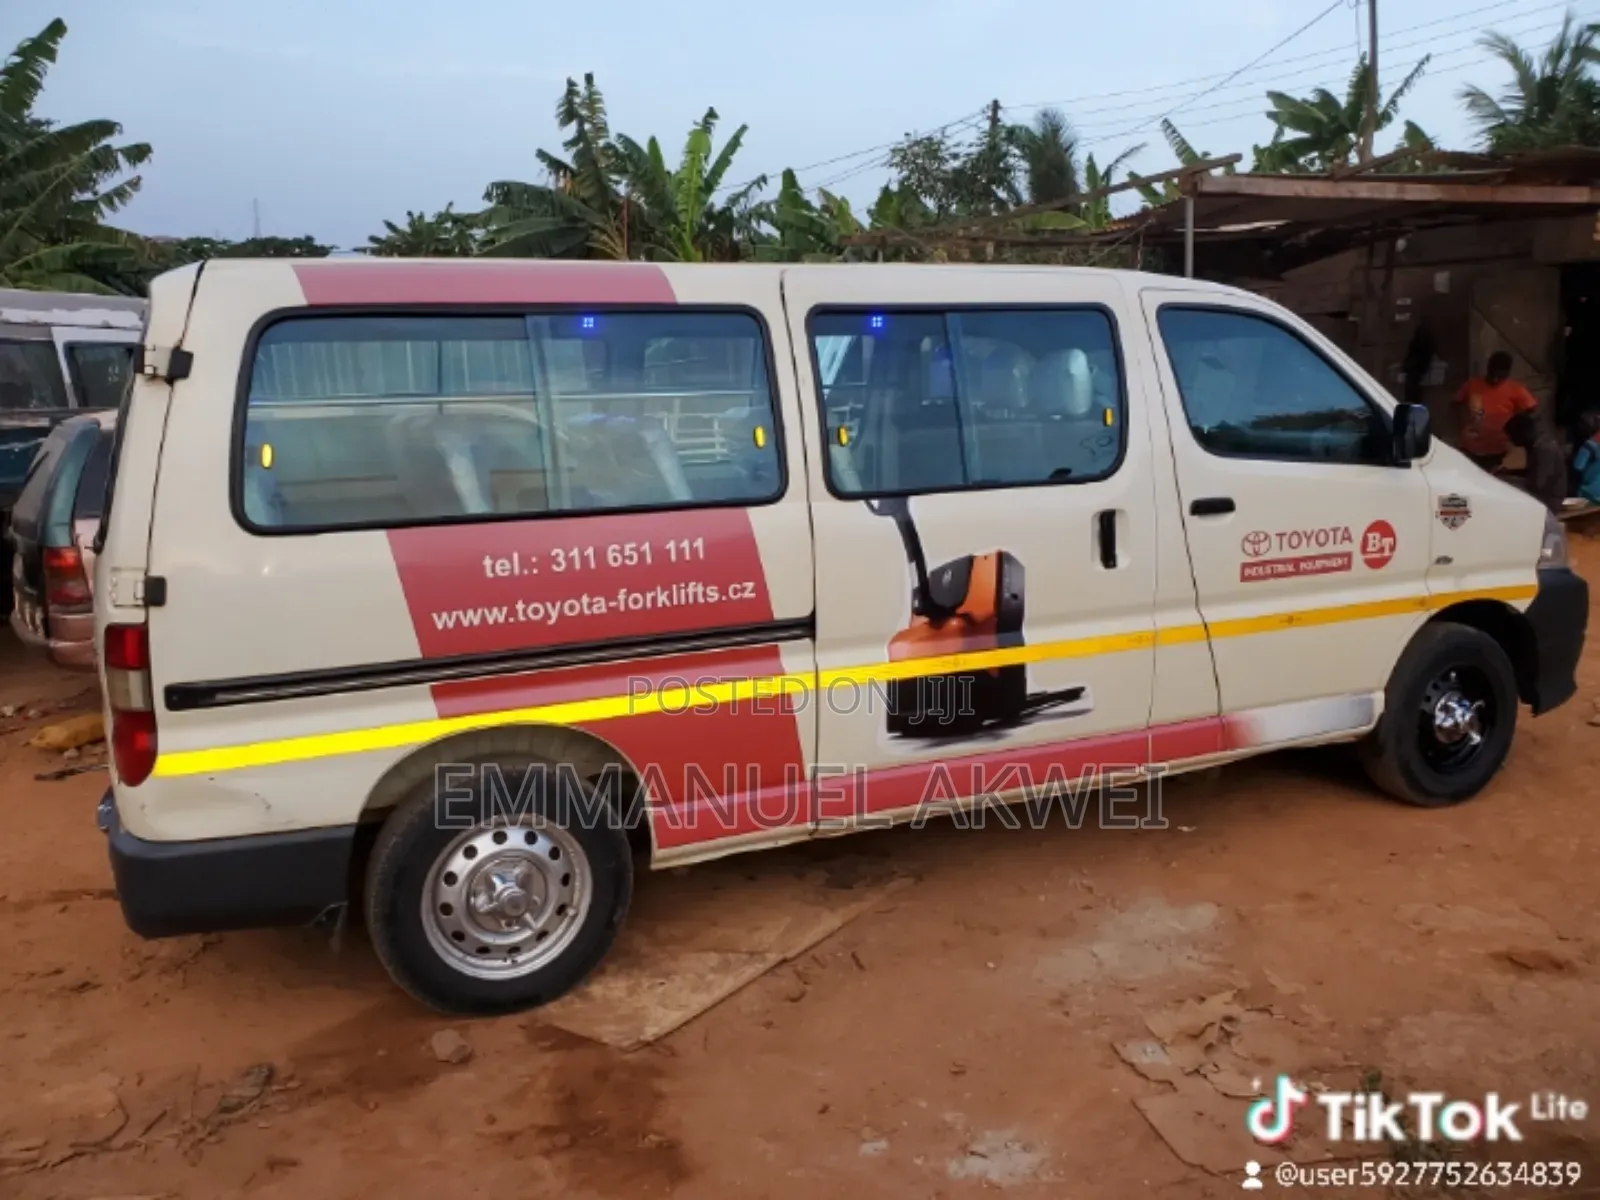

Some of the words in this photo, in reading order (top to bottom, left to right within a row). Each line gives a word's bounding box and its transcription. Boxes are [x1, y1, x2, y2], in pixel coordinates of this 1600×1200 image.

[483, 551, 539, 578] tel.:
[550, 545, 597, 573] 311
[606, 543, 653, 569] 651
[665, 537, 706, 562] 111
[1275, 526, 1353, 552] TOYOTA
[432, 580, 756, 631] www.toyota-forklifts.cz
